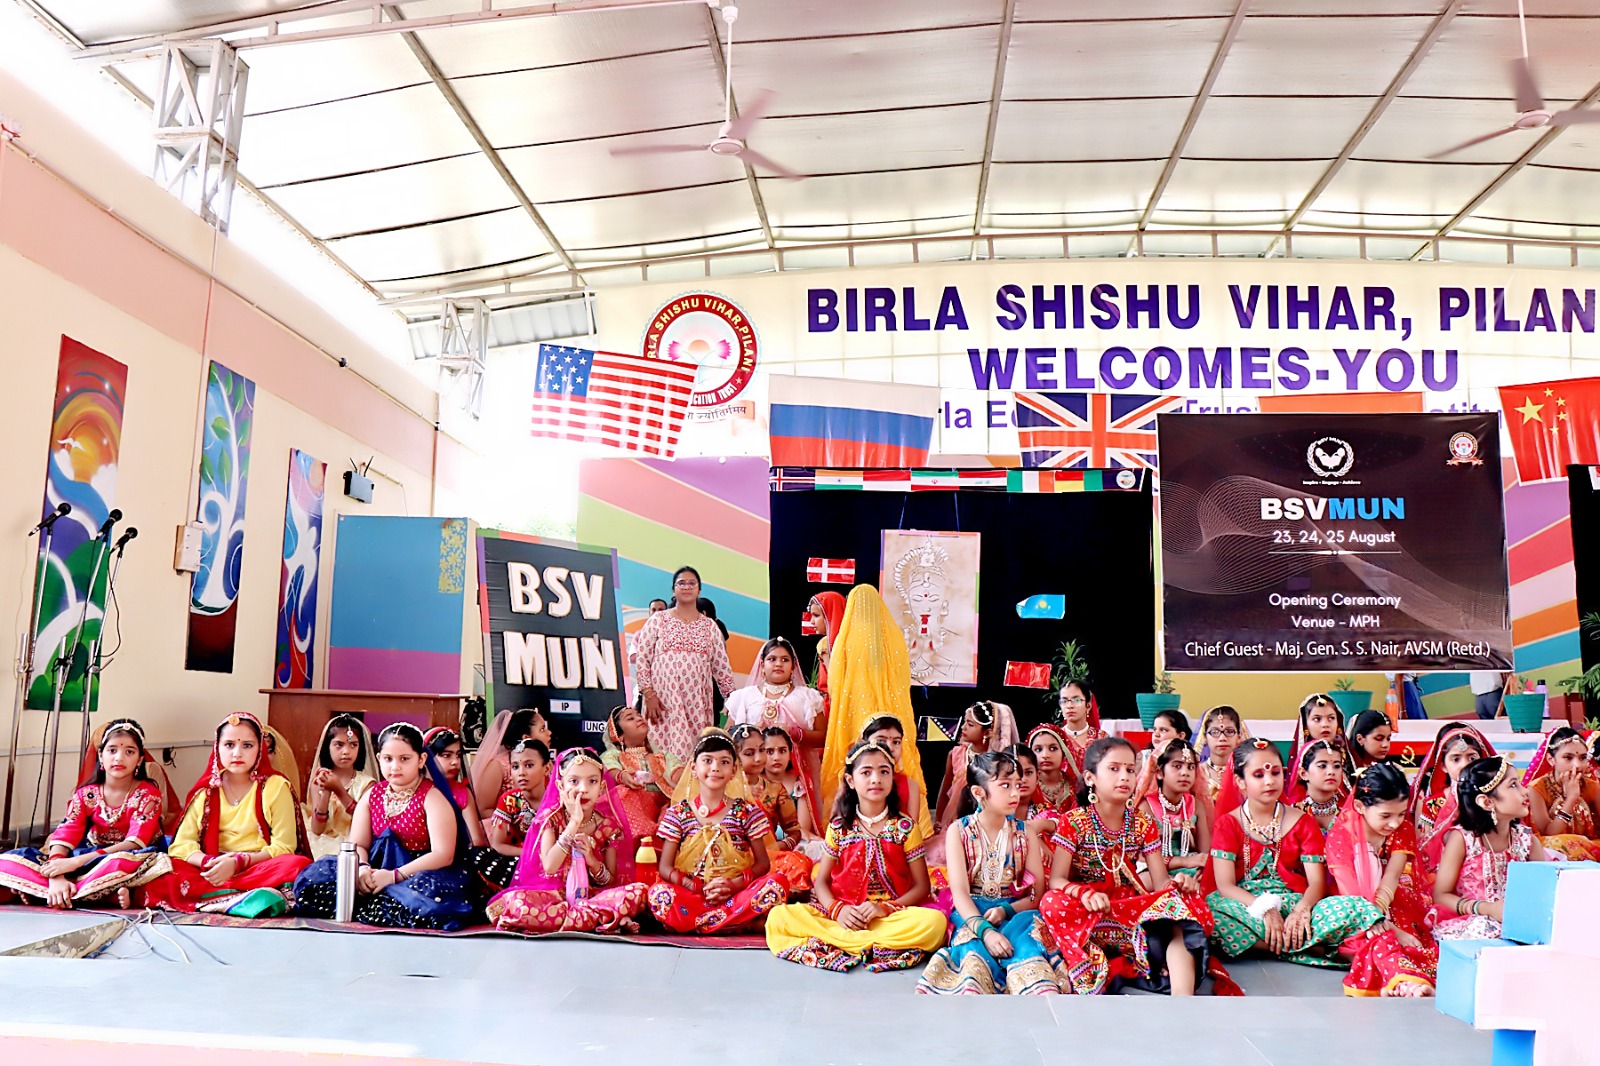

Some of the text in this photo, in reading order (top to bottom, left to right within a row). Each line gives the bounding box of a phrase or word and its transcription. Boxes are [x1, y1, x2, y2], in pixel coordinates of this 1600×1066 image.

[807, 284, 1596, 341] BIRLA SHISHU VIHAR, PILAN
[647, 333, 660, 358] RLA
[655, 298, 700, 331] SHISHU
[967, 345, 1459, 393] WELCOMES-YOU
[1260, 497, 1406, 521] BSVMUN
[1272, 529, 1396, 547] 23, 24, 25 August
[507, 561, 604, 620] BSV
[1268, 592, 1402, 610] Opening Ceremony
[1291, 615, 1336, 628] Venue
[1349, 614, 1380, 628] MPH
[503, 630, 618, 690] MUN
[1184, 641, 1222, 657] Chief
[1223, 641, 1264, 657] Guest
[1275, 641, 1304, 659] Maj.
[1306, 641, 1339, 656] Gen.
[1341, 641, 1353, 656] S.
[1356, 641, 1368, 656] S.
[1371, 641, 1401, 657] Nair,
[1403, 640, 1444, 656] AVSM
[1446, 640, 1491, 658] (Retd.)
[561, 702, 570, 711] IP
[586, 722, 606, 732] UNG
